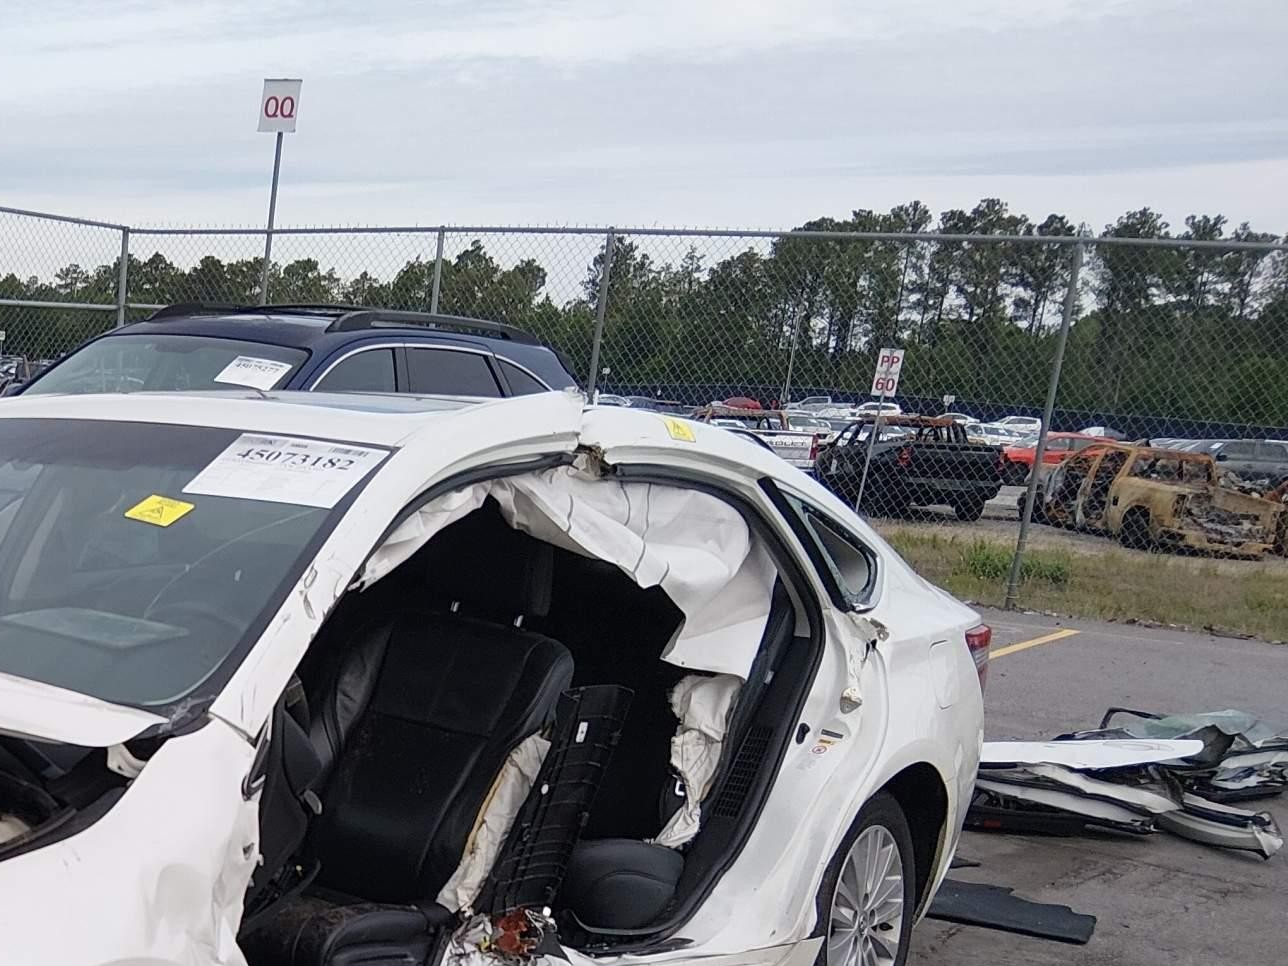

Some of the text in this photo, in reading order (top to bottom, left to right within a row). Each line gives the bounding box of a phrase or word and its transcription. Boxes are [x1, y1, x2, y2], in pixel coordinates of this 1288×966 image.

[264, 96, 295, 118] QQ
[880, 355, 900, 368] PP
[875, 377, 895, 392] 60
[236, 447, 355, 471] 45073182
